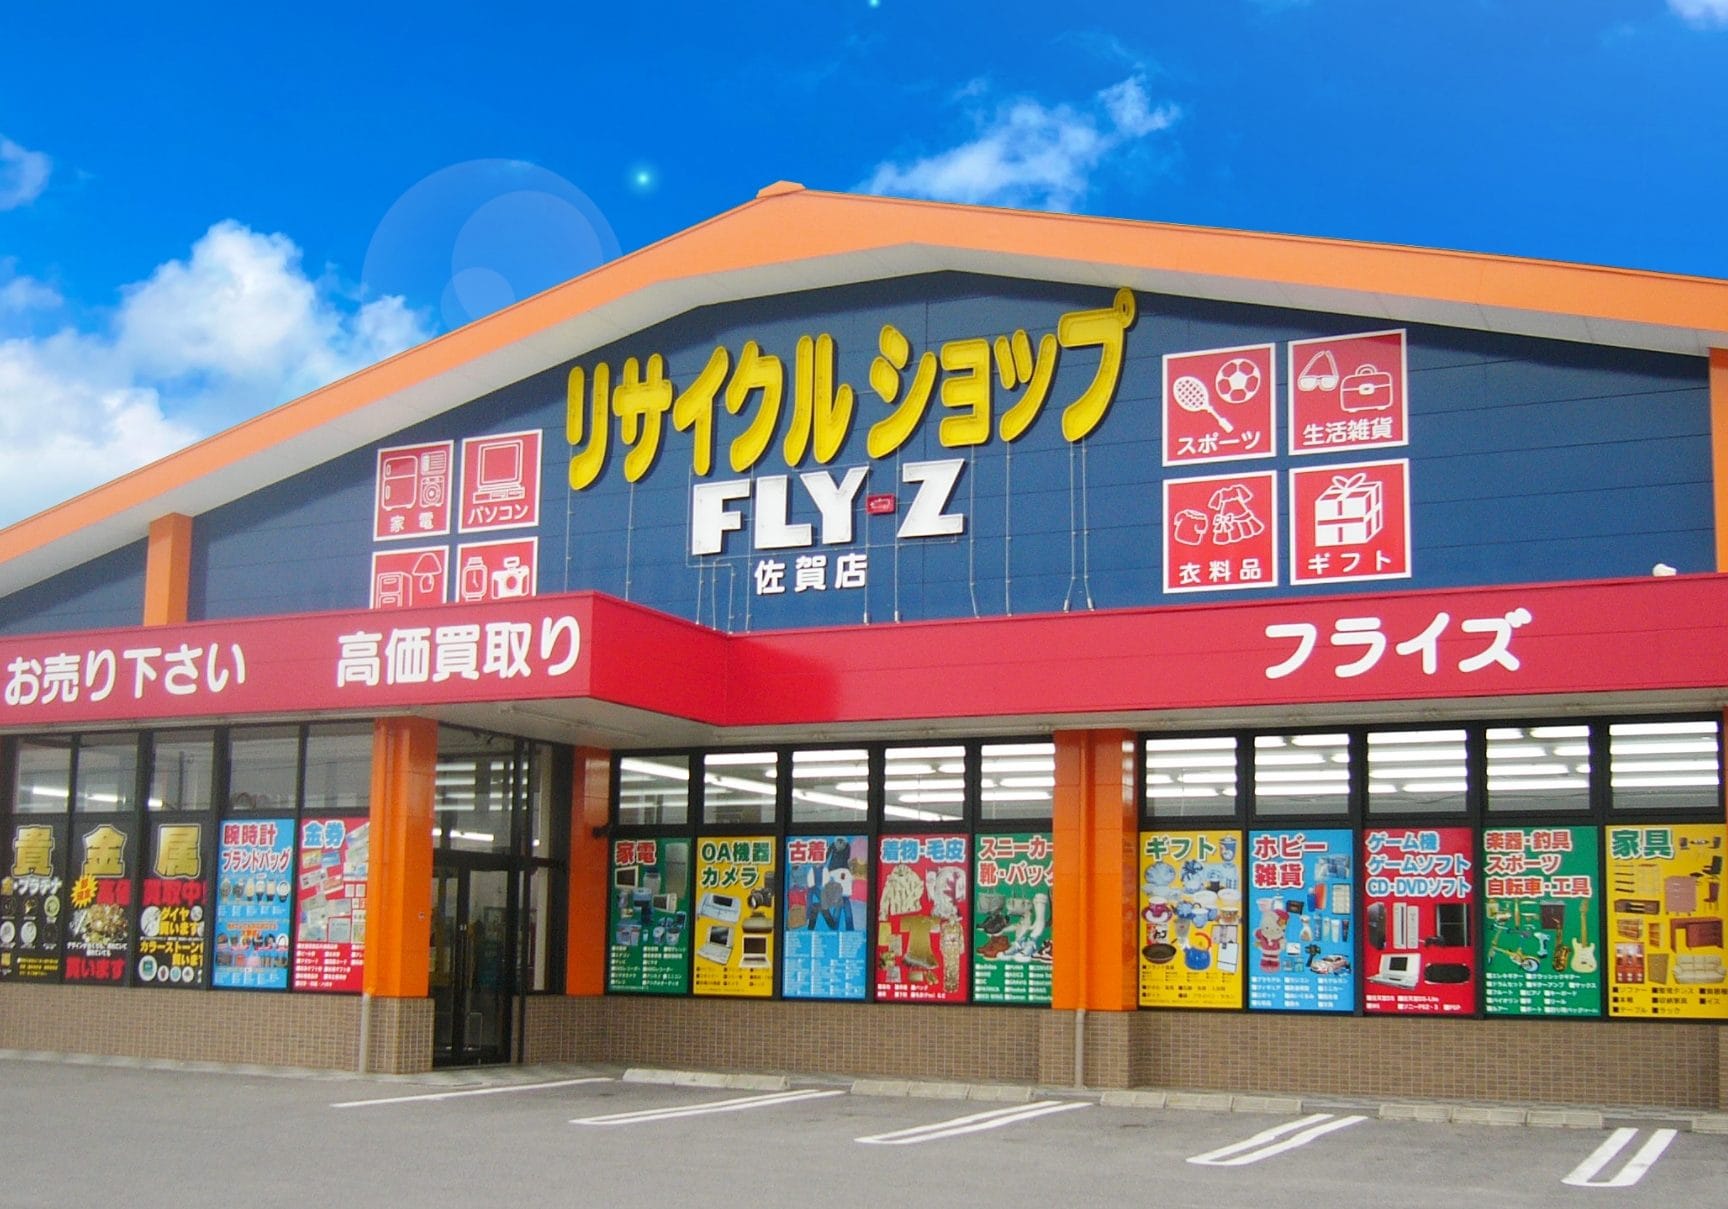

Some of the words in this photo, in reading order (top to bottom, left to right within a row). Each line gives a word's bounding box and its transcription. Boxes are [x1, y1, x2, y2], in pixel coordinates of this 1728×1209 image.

[566, 287, 1136, 491] リサイクルショップ
[1177, 430, 1261, 457] スポーツ
[1302, 417, 1393, 445] 生活雑貨
[390, 511, 434, 533] 家電
[468, 504, 529, 525] パソコン
[754, 553, 869, 596] 佐賀店
[1179, 559, 1261, 585] 衣料品
[1308, 551, 1392, 575] ギフト
[1265, 608, 1532, 679] フライズ
[4, 642, 246, 706] お売り下さい
[337, 616, 582, 688] 高価買取り
[222, 822, 277, 847] 腕時計
[303, 820, 346, 849] 金券
[1254, 834, 1328, 860] ホビー
[1366, 831, 1439, 852] ゲーム機
[1484, 829, 1573, 852] 楽器・釣具
[1611, 829, 1674, 860] 家具
[222, 847, 292, 872] ブランドバッグ
[614, 840, 657, 865] 家電
[700, 840, 772, 864] OA機器
[788, 839, 828, 864] 古着
[880, 837, 966, 864] 着物・毛皮
[1146, 835, 1216, 862] ギフト
[1254, 862, 1304, 889] 雑貨
[1366, 854, 1472, 875] ゲームソフト
[1484, 852, 1561, 874] スポーツ
[701, 866, 759, 888] カメラ
[1366, 877, 1472, 898] CD・DVDソフト
[1485, 875, 1592, 898] 自転車・工具
